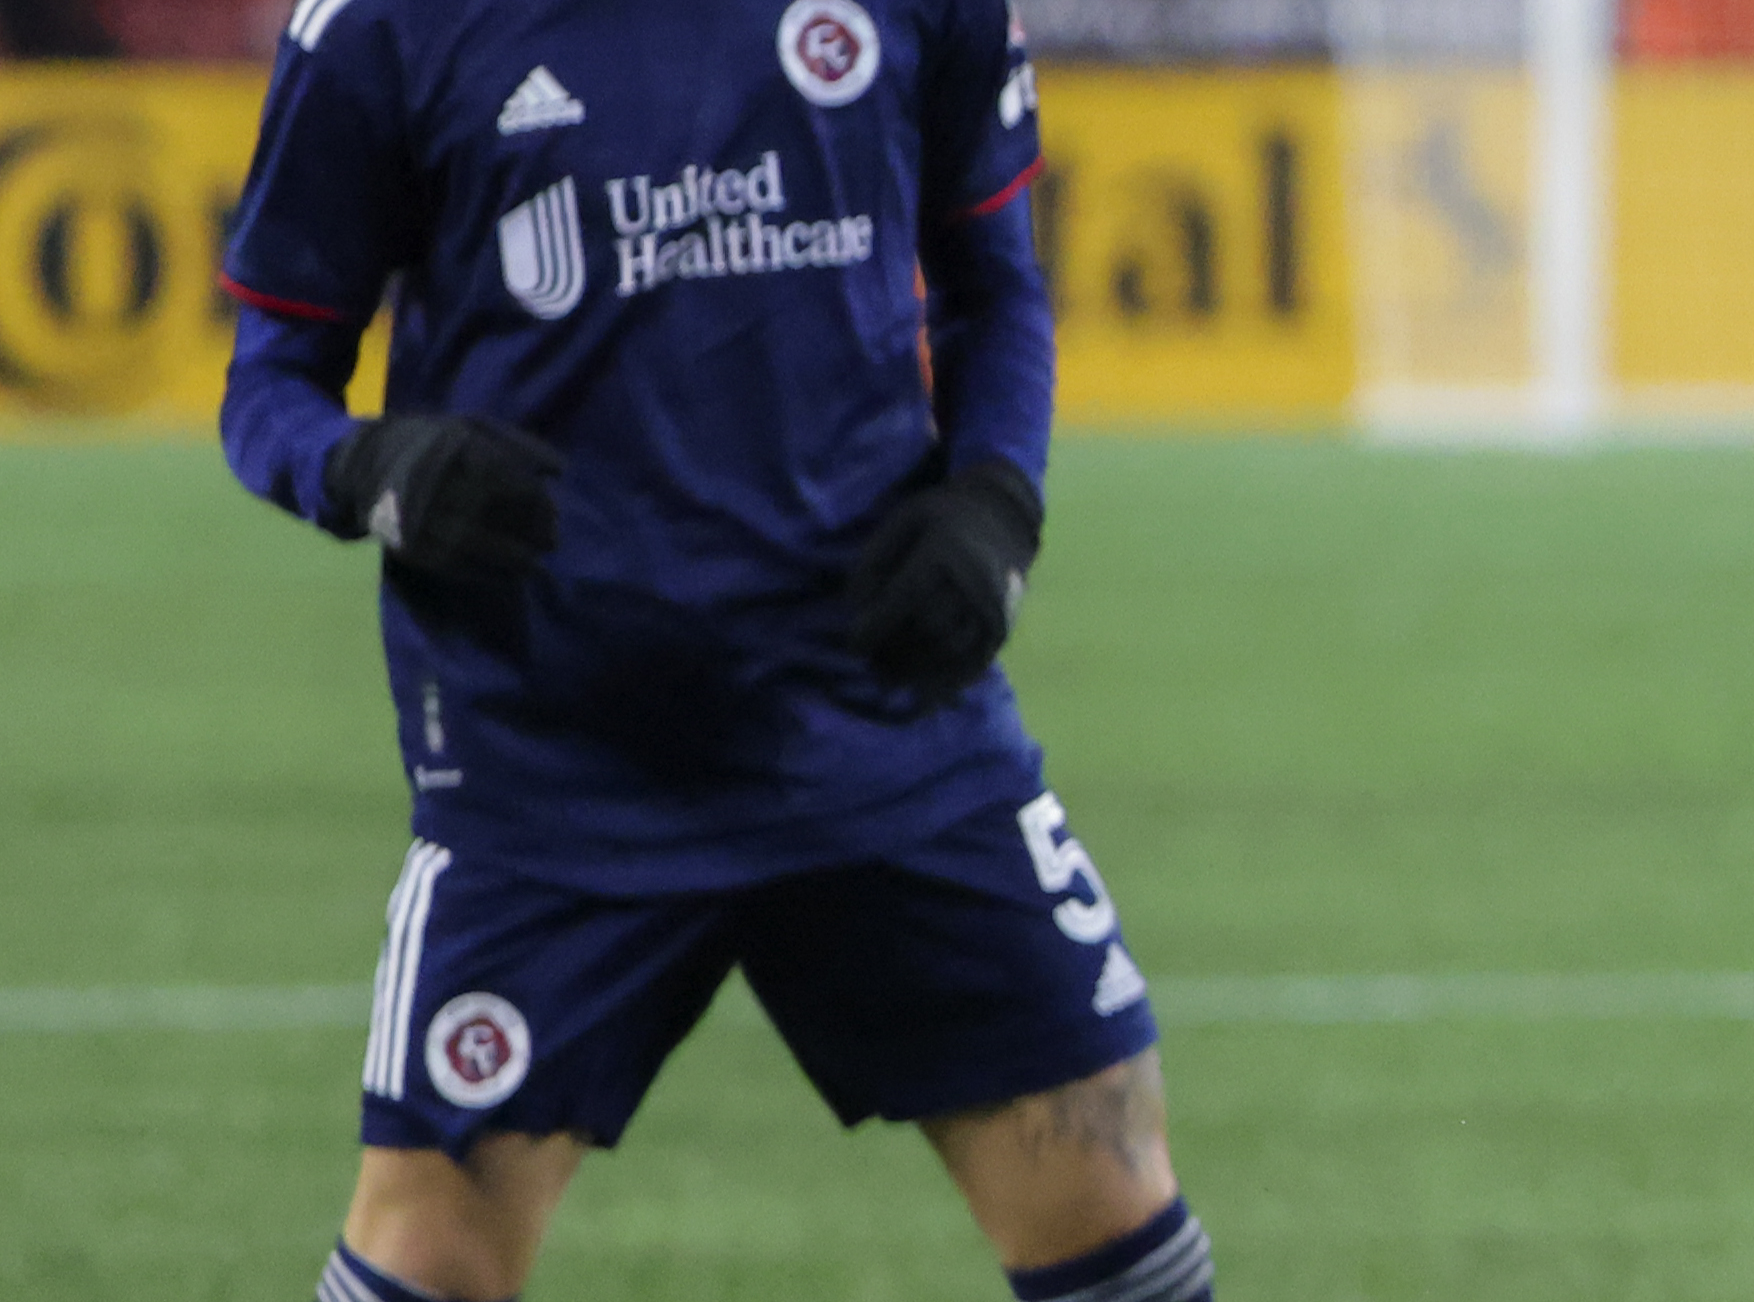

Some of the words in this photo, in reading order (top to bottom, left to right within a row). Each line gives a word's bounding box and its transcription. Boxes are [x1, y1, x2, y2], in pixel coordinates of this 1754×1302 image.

[605, 150, 787, 236] United
[616, 214, 875, 298] Healthcare
[1016, 790, 1116, 944] 5
